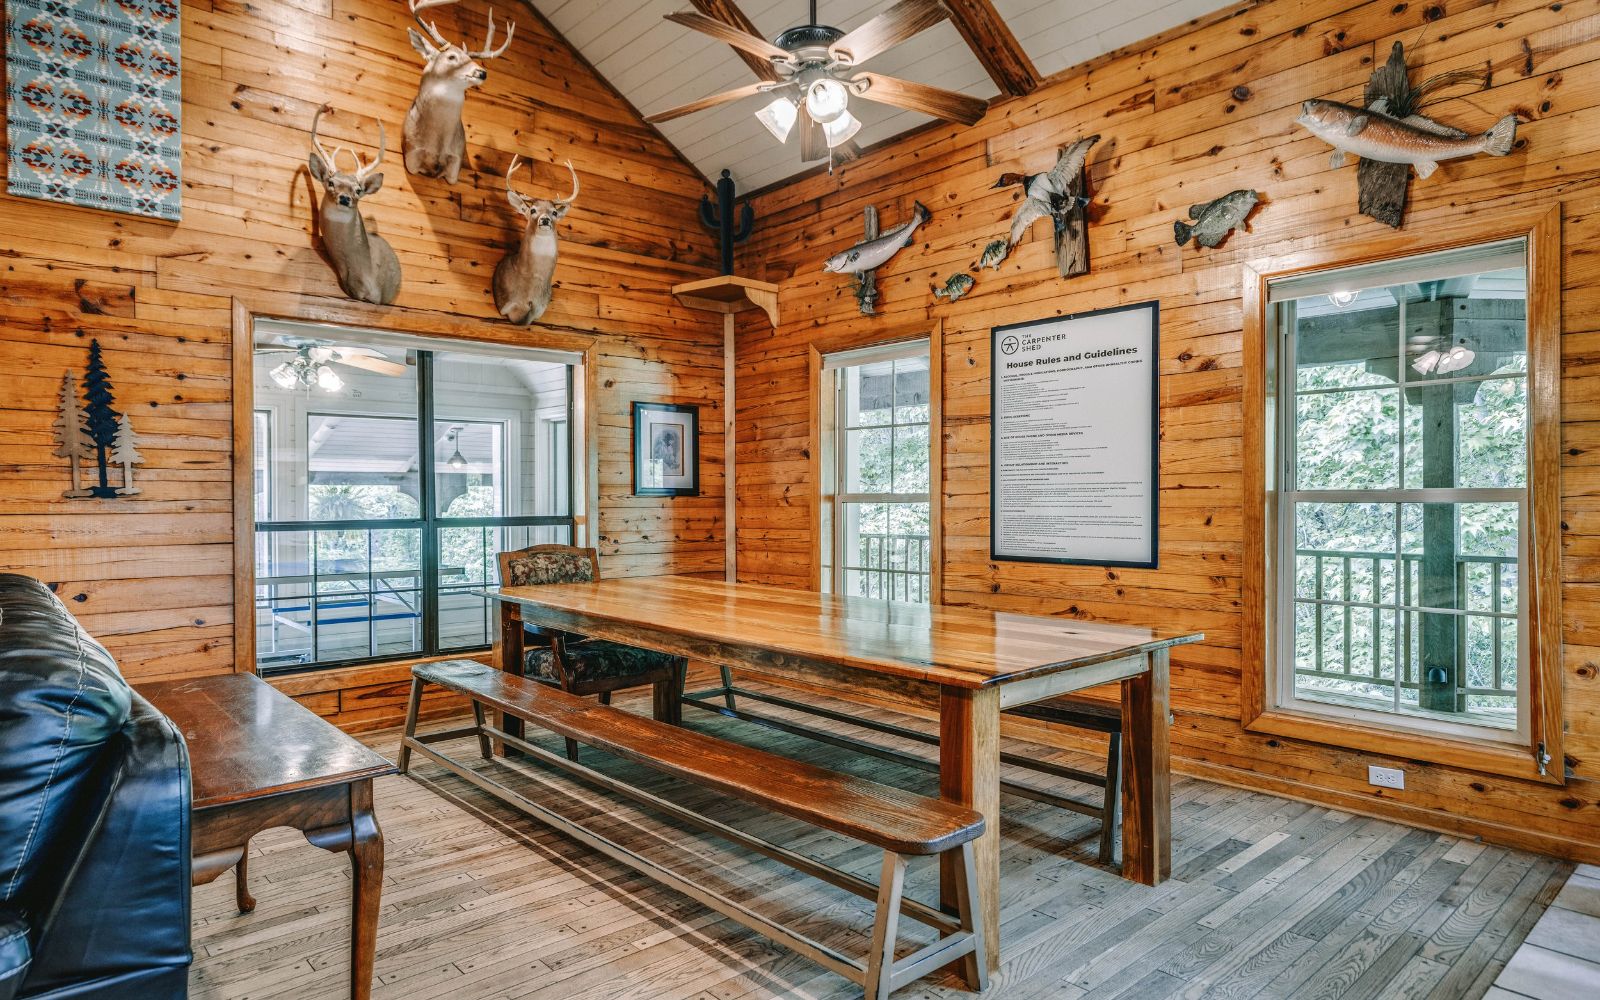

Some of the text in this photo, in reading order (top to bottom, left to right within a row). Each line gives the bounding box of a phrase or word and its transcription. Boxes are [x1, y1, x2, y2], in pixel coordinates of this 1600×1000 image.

[1022, 334, 1066, 345] CARPENTER
[1006, 347, 1137, 369] House Rules and Guidelines
